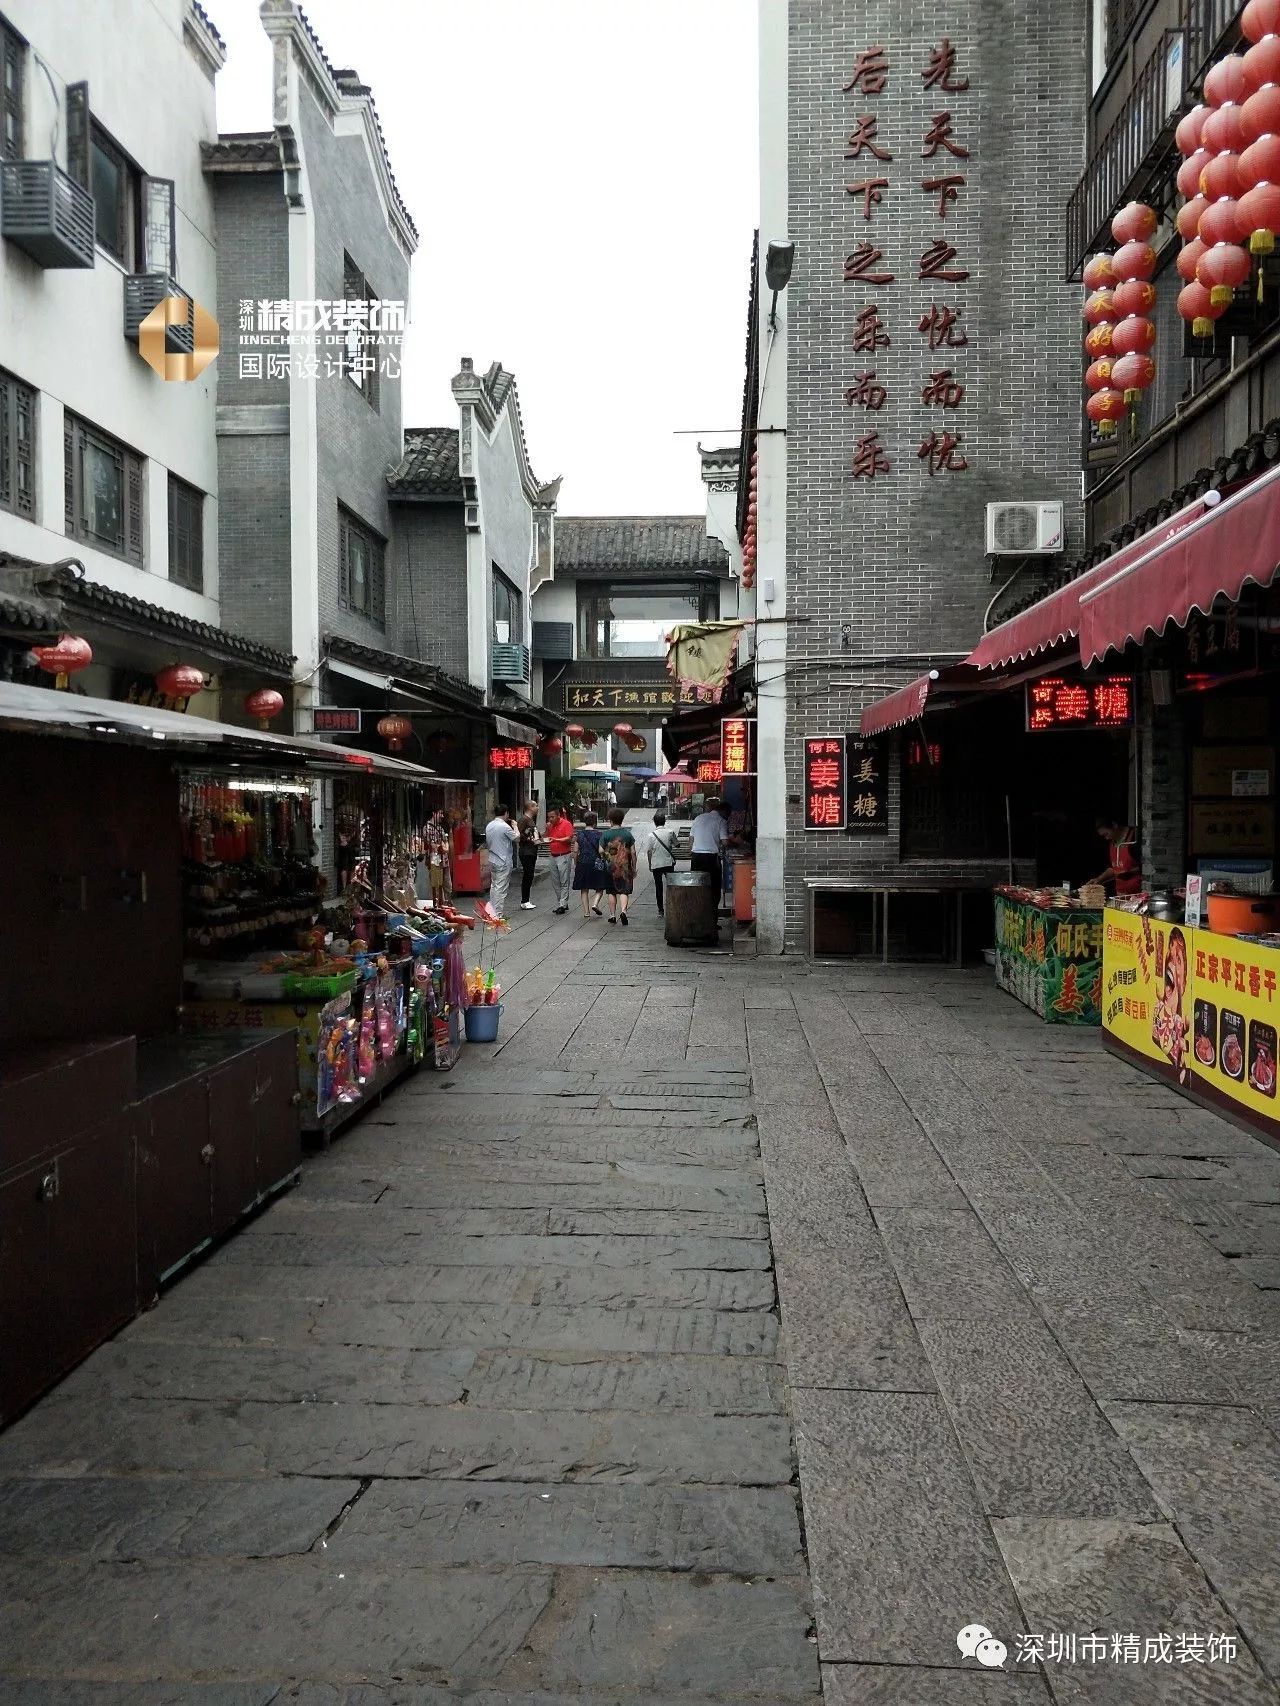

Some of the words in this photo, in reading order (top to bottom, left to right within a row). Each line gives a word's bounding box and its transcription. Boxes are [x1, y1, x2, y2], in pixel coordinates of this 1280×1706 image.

[917, 38, 970, 472] 先天下之忧而忧
[1055, 684, 1128, 720] 姜糖
[809, 758, 841, 825] 姜糖
[852, 756, 879, 818] 姜糖
[1195, 949, 1277, 1003] 正宗平江香干
